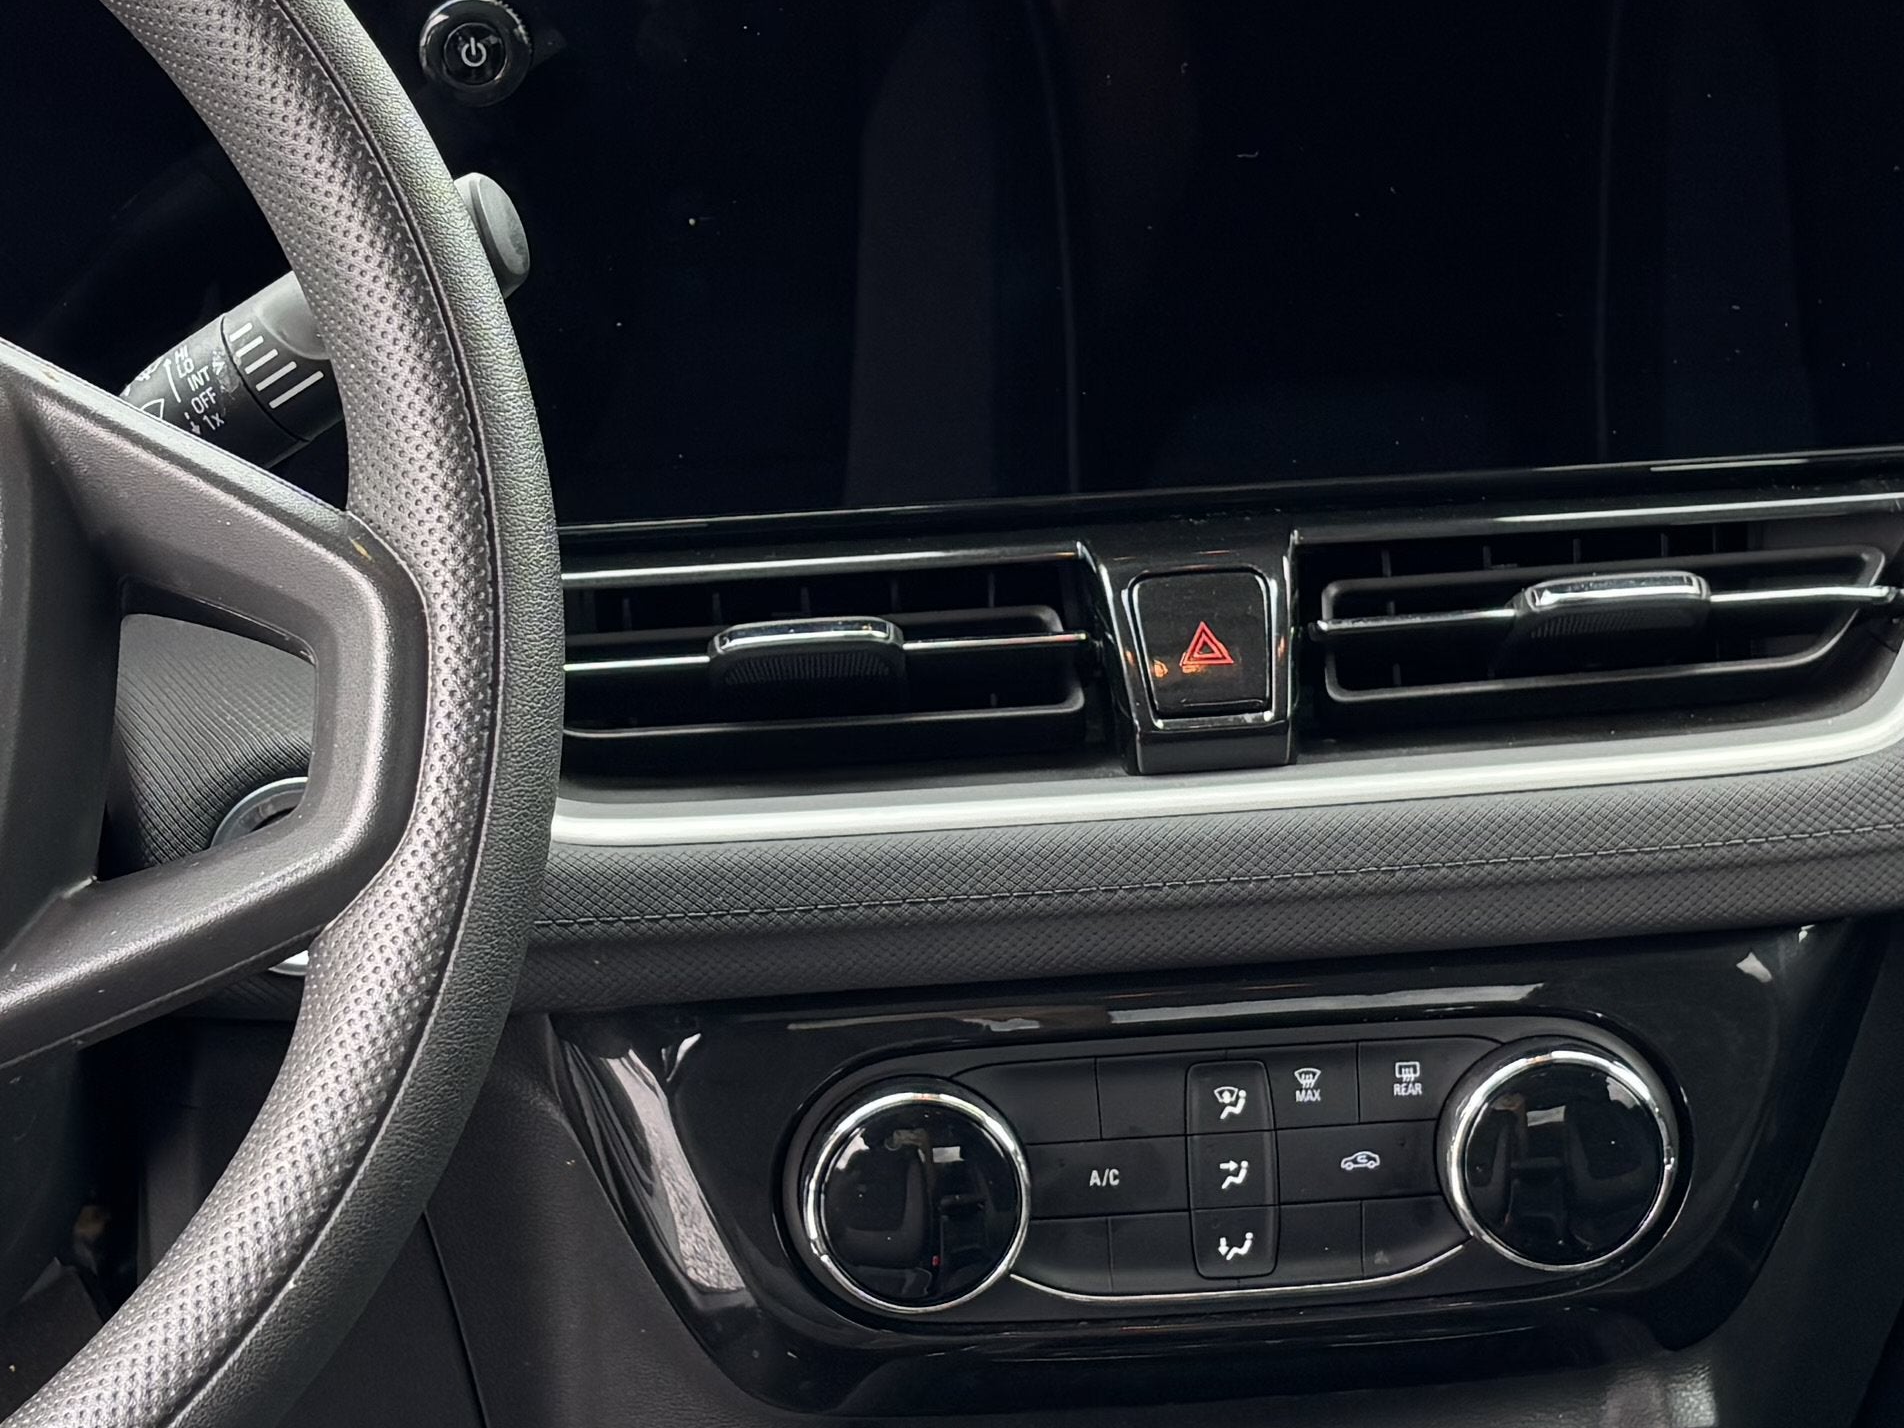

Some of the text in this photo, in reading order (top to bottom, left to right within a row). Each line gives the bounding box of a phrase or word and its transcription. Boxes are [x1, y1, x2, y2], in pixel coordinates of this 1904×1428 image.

[175, 345, 189, 365] HI
[176, 357, 195, 379] LO
[187, 365, 211, 392] INT
[191, 386, 217, 414] OFF
[1295, 1088, 1322, 1103] MAX
[1392, 1082, 1423, 1097] REAR
[1089, 1168, 1121, 1187] A/C
